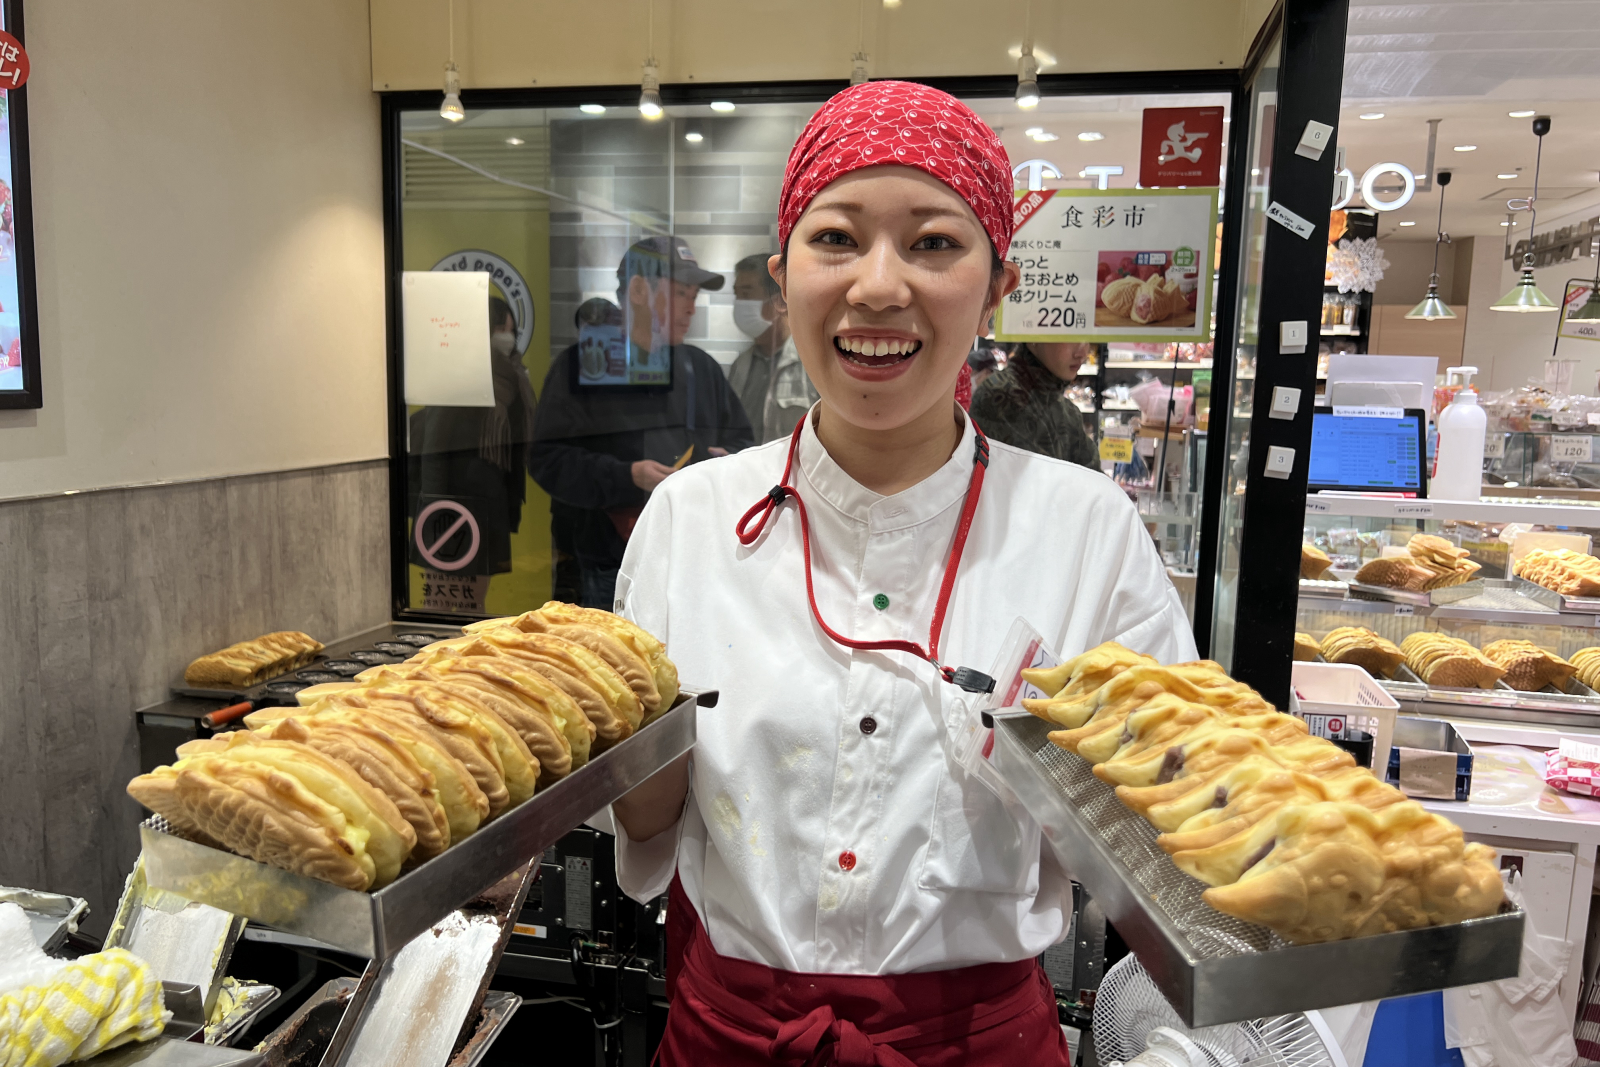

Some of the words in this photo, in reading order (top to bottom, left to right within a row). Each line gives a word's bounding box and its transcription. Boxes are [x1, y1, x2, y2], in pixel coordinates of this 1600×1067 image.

[1314, 131, 1321, 139] 6
[1012, 192, 1044, 230] 告の品
[1060, 205, 1146, 229] 食彩市
[1017, 272, 1079, 287] ちおとめ
[1009, 289, 1077, 304] 苺クリーム
[1037, 307, 1076, 328] 220
[1283, 396, 1291, 404] 2
[1277, 455, 1285, 464] 3
